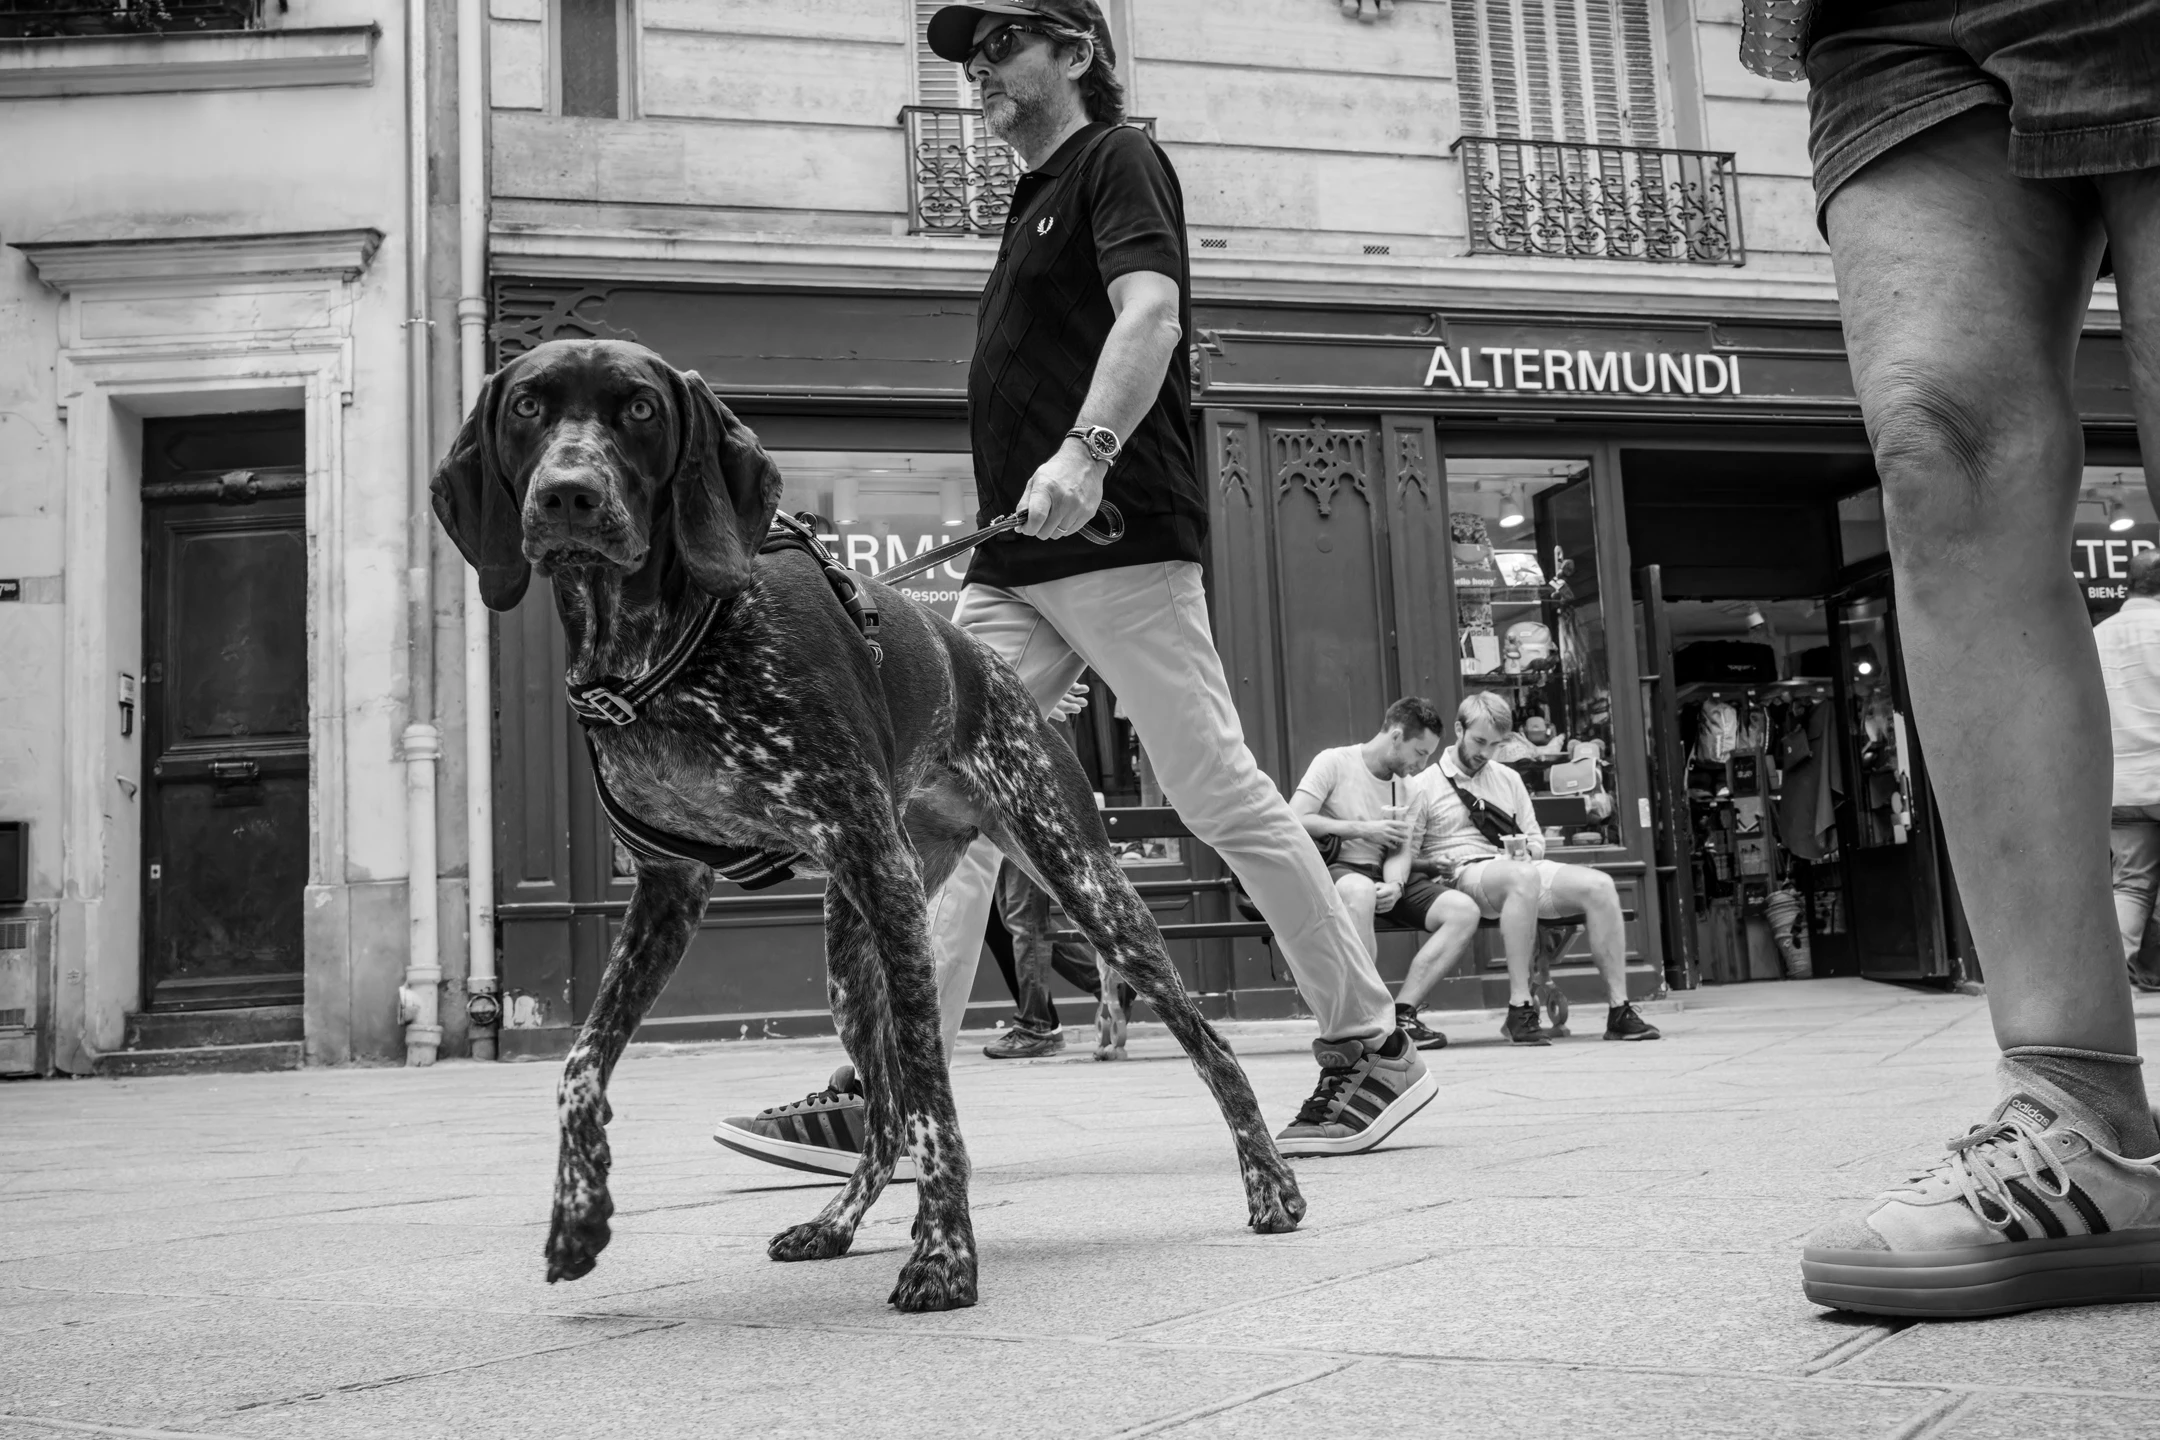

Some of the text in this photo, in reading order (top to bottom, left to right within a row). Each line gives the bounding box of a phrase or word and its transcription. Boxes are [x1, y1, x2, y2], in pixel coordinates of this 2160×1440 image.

[1424, 345, 1742, 395] ALTERMUNDI
[902, 587, 961, 604] Respon
[2011, 1099, 2050, 1127] adidas
